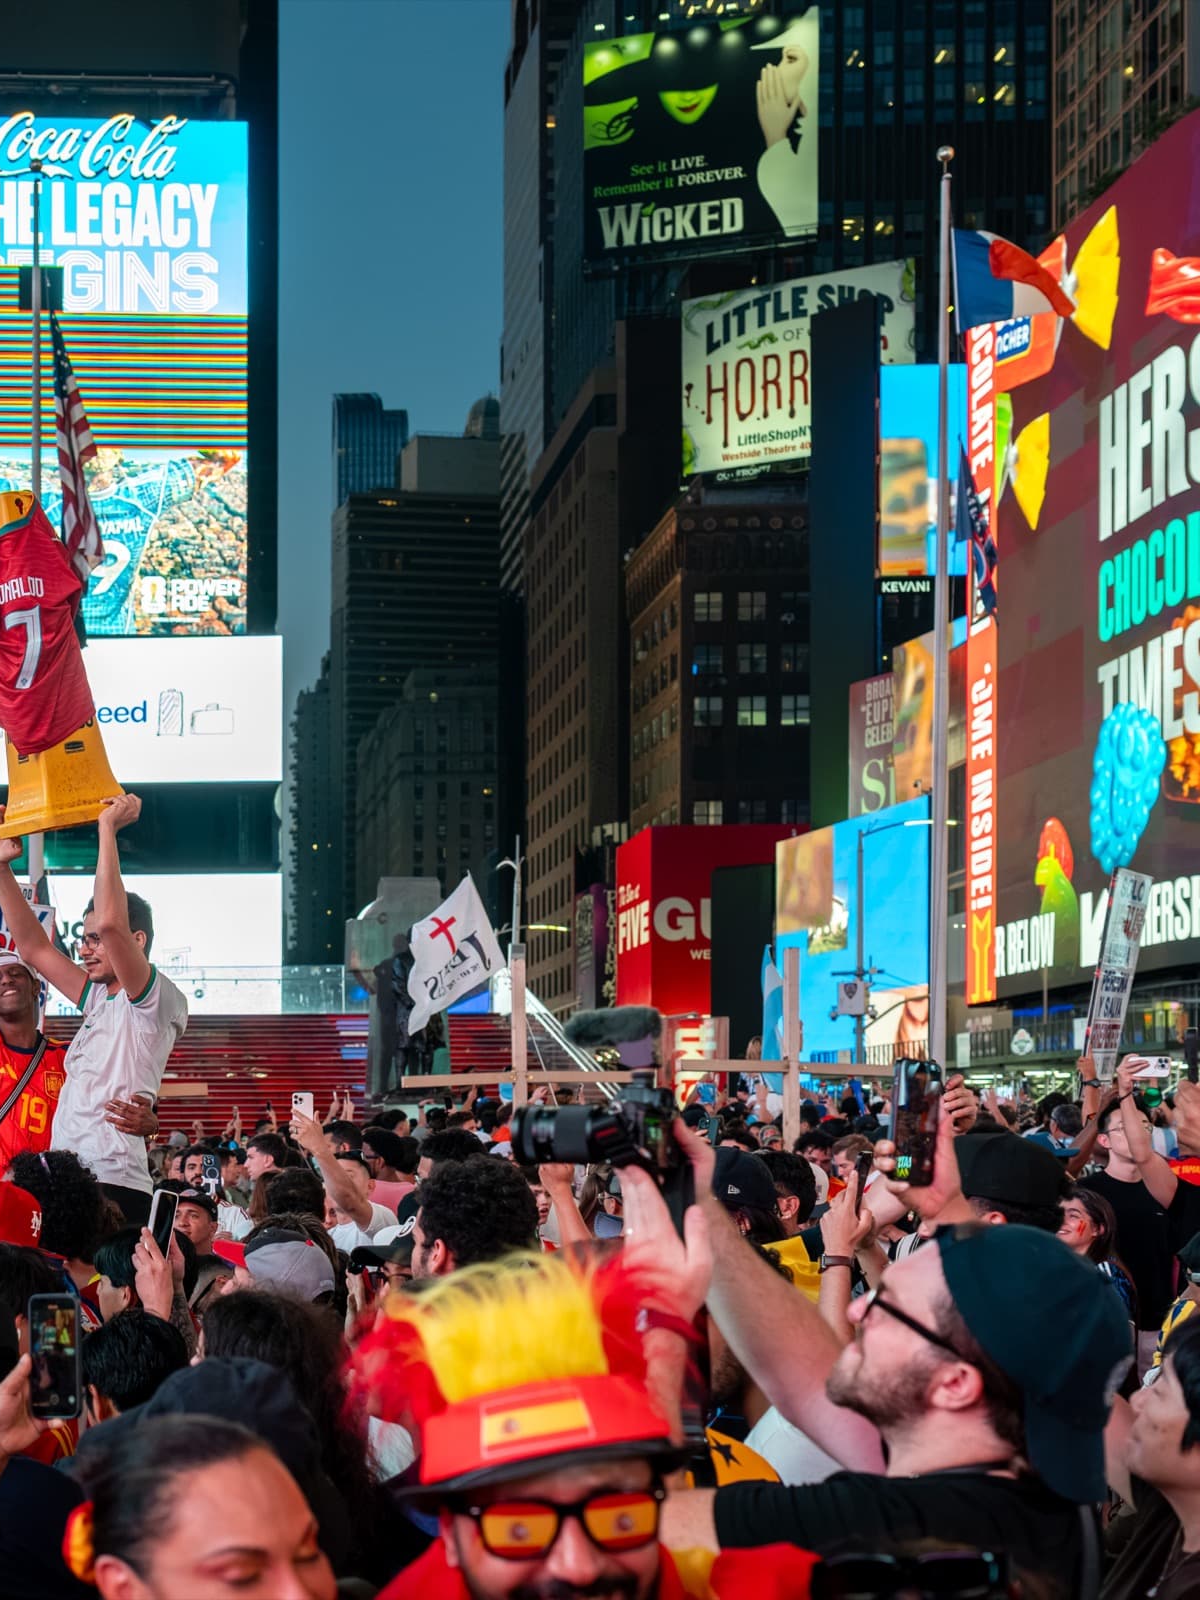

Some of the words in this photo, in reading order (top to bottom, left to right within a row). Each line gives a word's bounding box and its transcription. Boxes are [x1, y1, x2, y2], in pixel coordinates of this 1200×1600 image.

[593, 179, 662, 199] Remember
[665, 177, 674, 189] it
[678, 166, 748, 188] FOREVER.
[631, 163, 652, 177] See
[658, 159, 668, 172] it
[51, 180, 220, 249] LEGACY
[706, 285, 809, 357] LITTLE
[881, 580, 931, 593] KEVANI
[4, 604, 43, 690] 7
[971, 767, 993, 911] INSIDE!
[618, 899, 650, 954] FIVE
[1007, 911, 1055, 974] BELOW
[19, 1092, 48, 1135] 19
